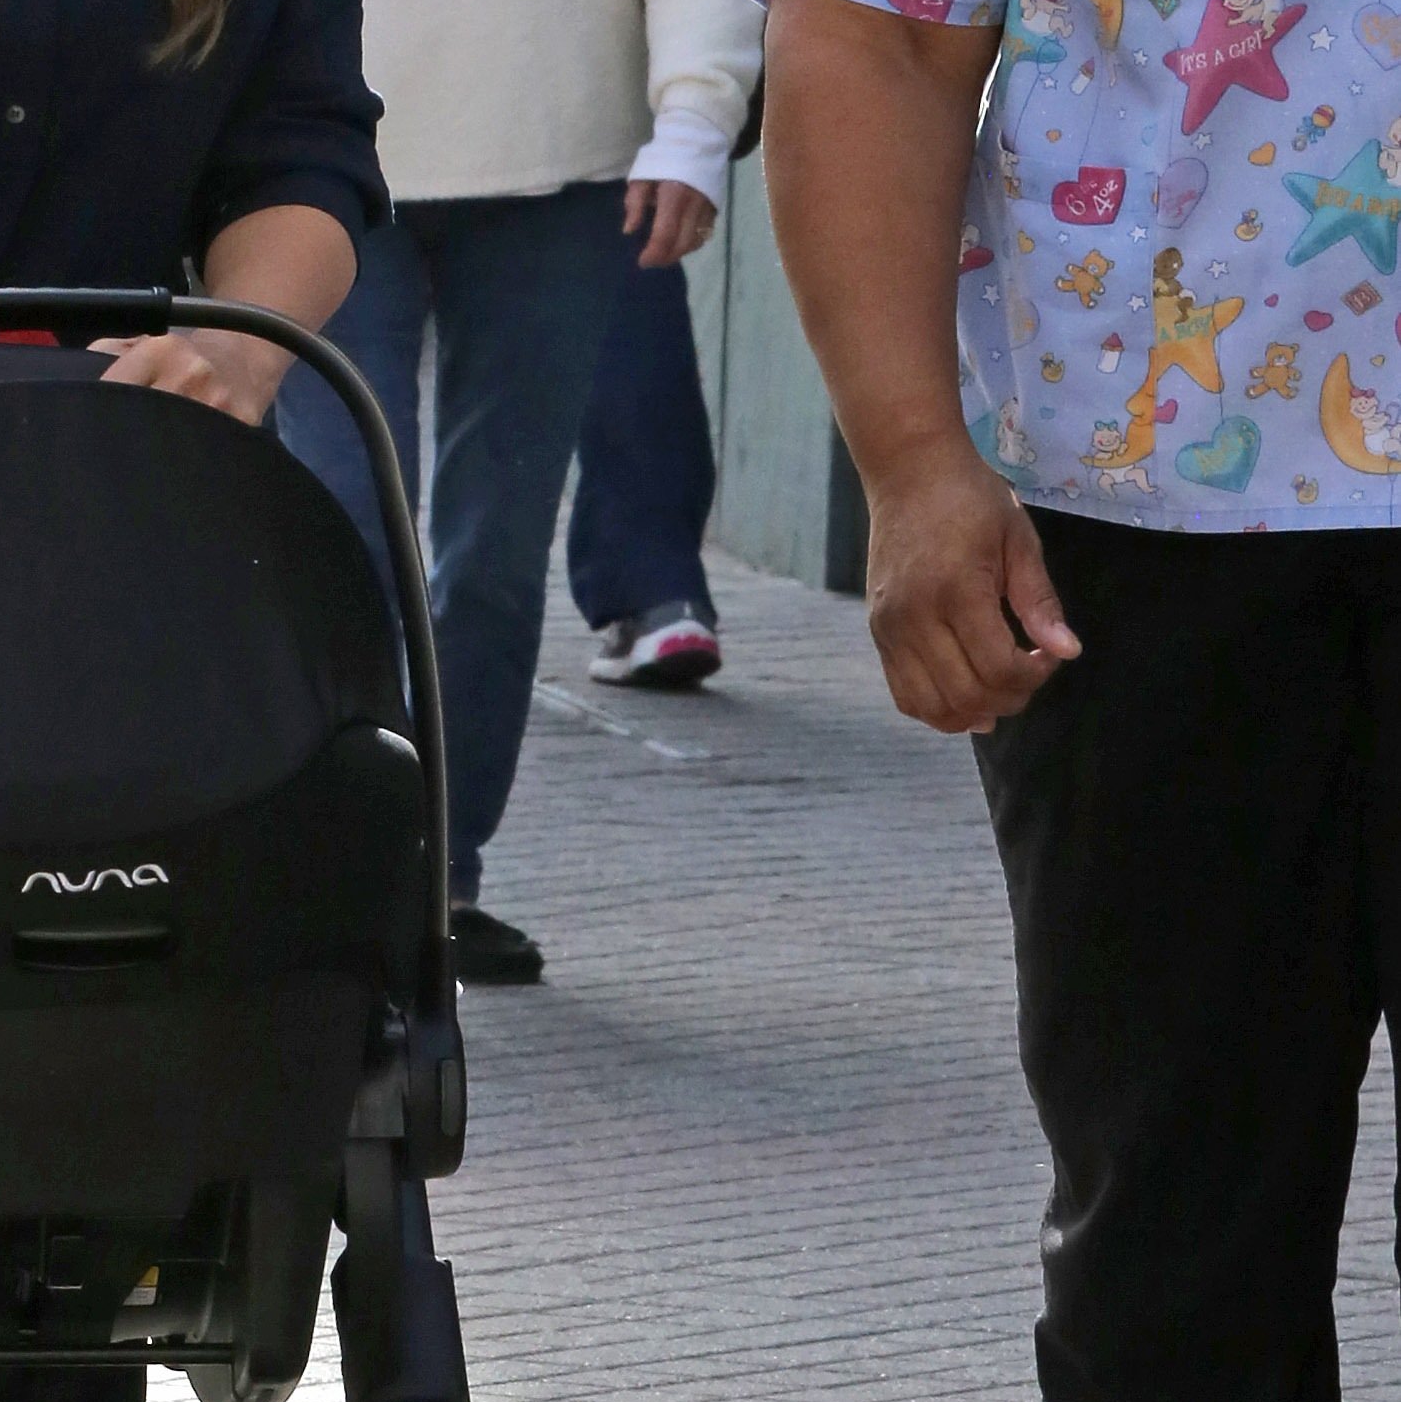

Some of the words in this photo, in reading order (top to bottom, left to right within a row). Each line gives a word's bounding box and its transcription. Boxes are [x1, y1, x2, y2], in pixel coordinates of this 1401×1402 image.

[1180, 51, 1207, 76] IT'S
[1214, 49, 1225, 66] A
[1229, 29, 1262, 59] GIRL
[21, 863, 170, 894] nuna
